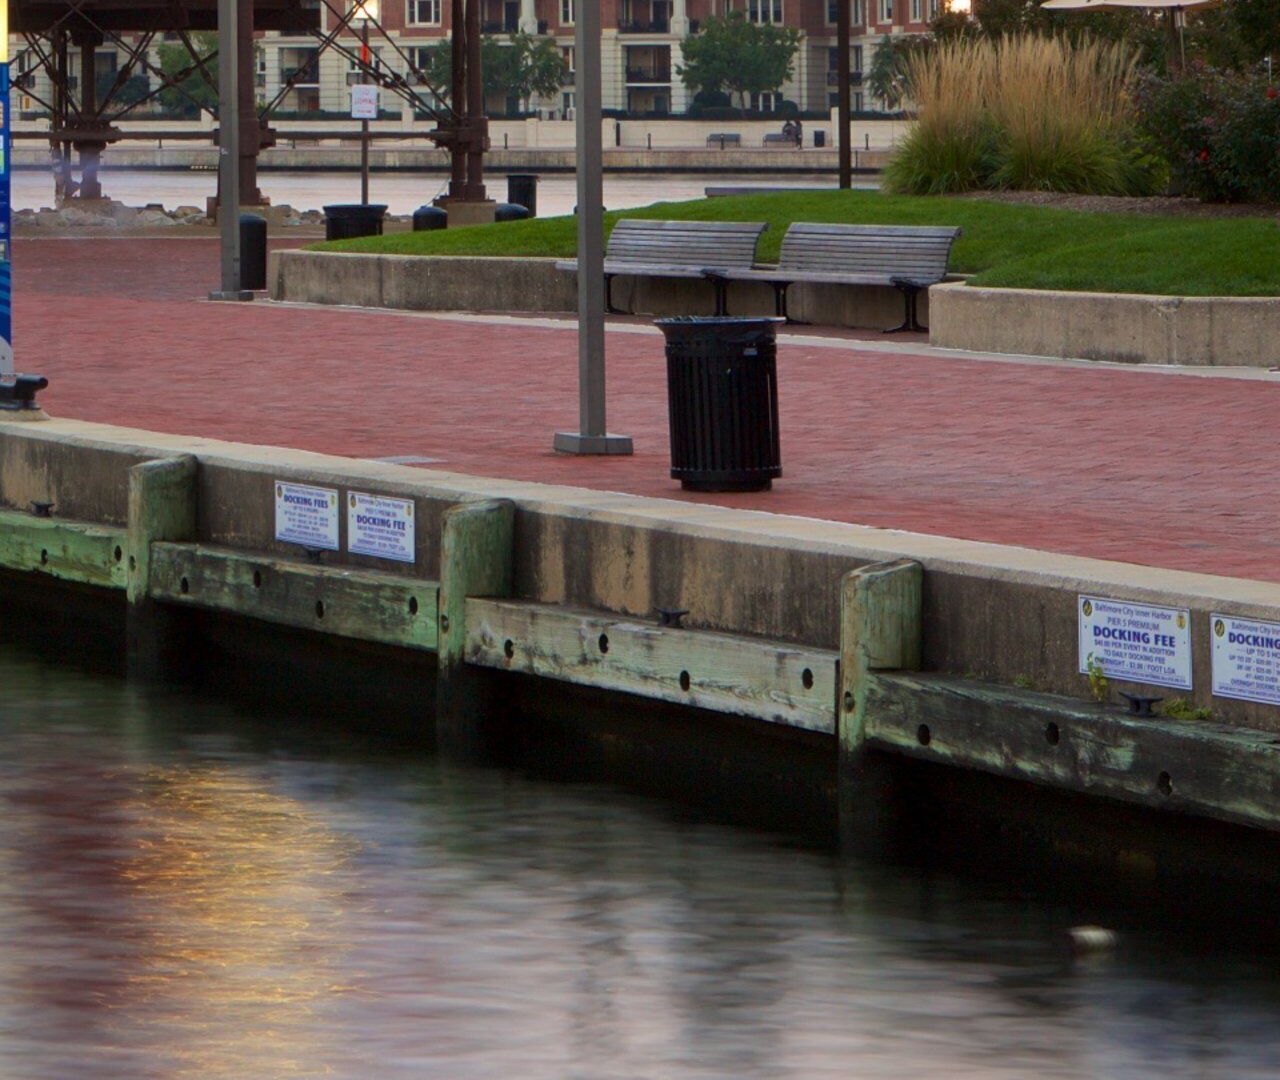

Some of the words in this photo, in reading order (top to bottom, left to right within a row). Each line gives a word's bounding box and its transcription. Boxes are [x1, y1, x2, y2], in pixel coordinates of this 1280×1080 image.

[284, 494, 312, 506] DOCKING
[314, 499, 328, 508] FEES
[357, 514, 391, 528] DOCKING
[393, 520, 406, 530] FEE
[1095, 602, 1121, 613] Baltimore
[1122, 607, 1134, 617] City
[1152, 610, 1172, 620] Harbor
[1107, 616, 1120, 626] PIER
[1128, 619, 1160, 631] PREMIUM
[1260, 625, 1271, 635] City
[1093, 625, 1150, 644] DOCKING
[1154, 634, 1175, 648] FEE
[1228, 632, 1280, 650] DOCKING
[1123, 641, 1140, 652] EVENT
